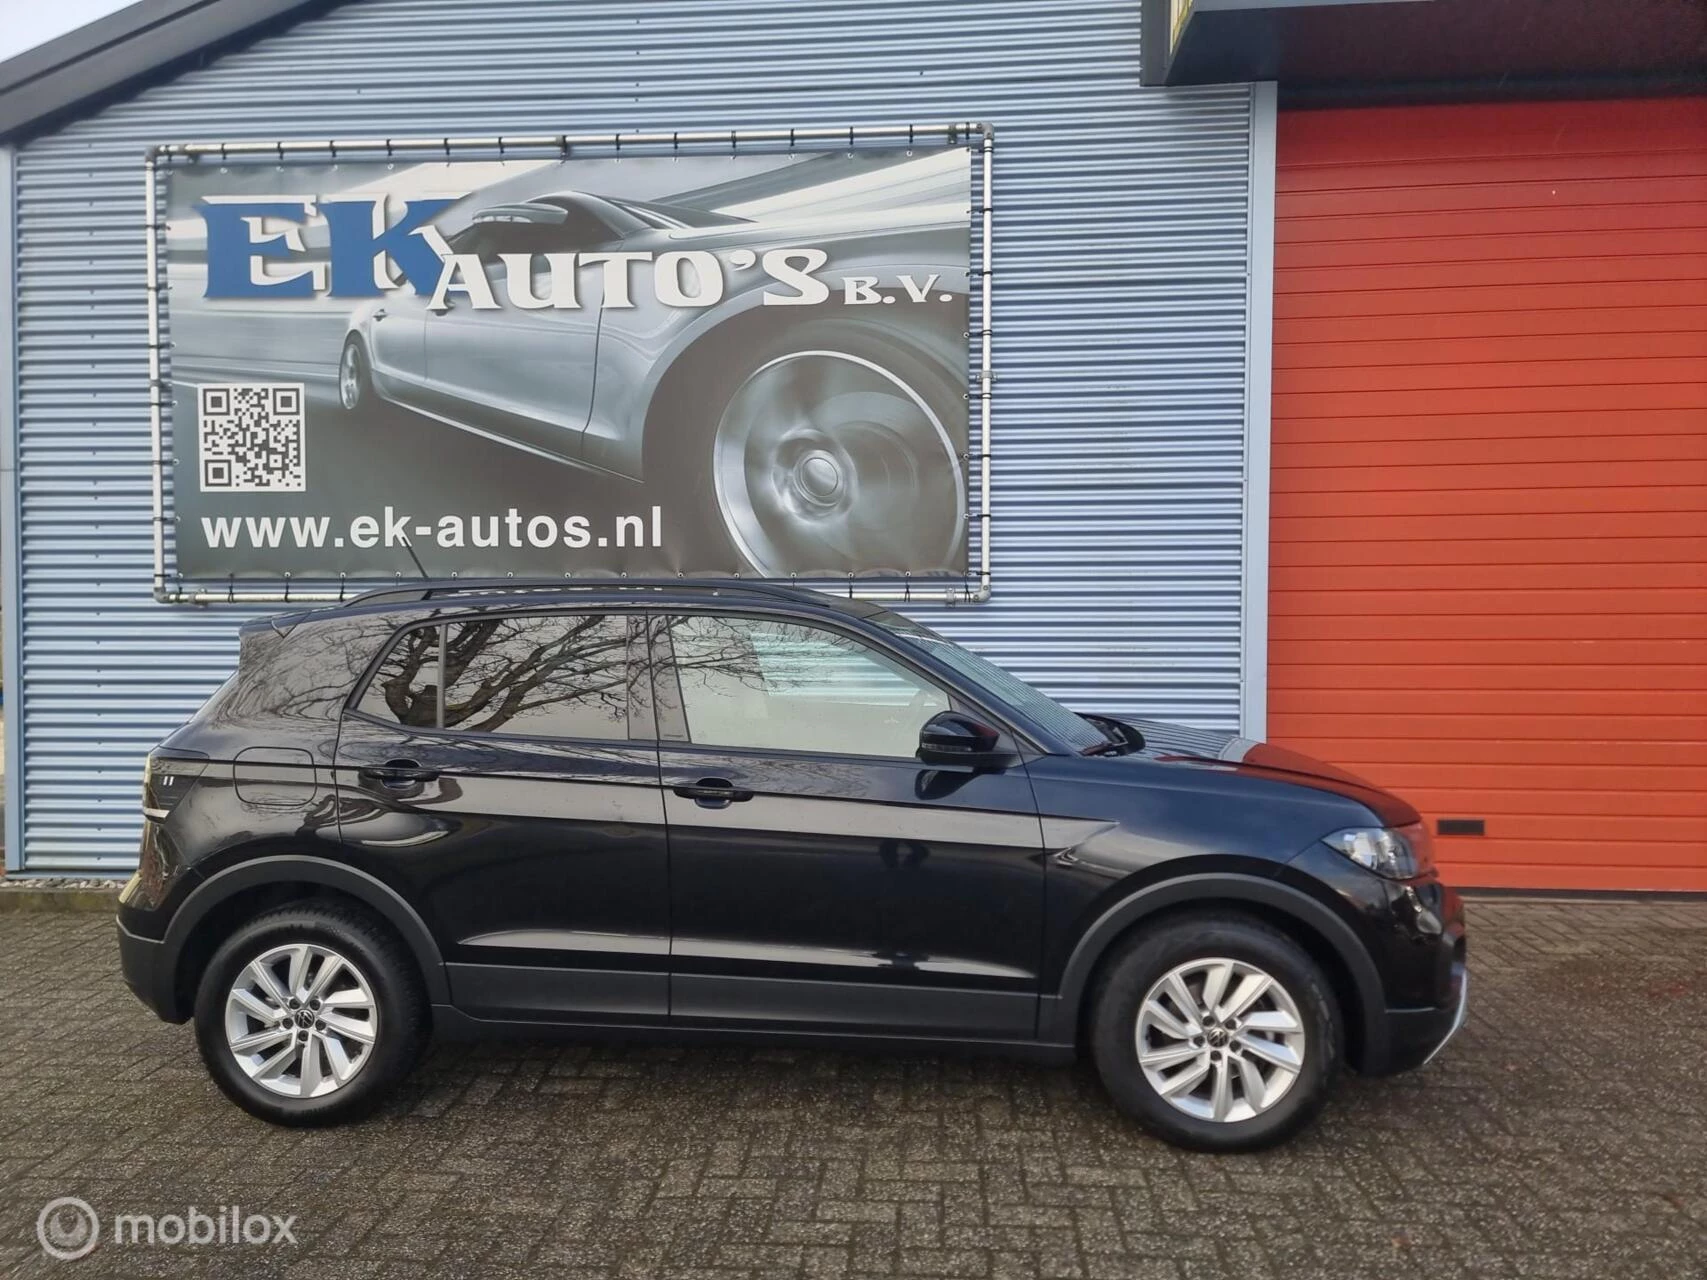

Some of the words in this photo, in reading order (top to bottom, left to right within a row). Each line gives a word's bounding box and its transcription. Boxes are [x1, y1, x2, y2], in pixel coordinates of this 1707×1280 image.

[200, 193, 472, 298] EK
[842, 274, 953, 305] B.V.
[201, 505, 662, 548] www.ek-autos.nl
